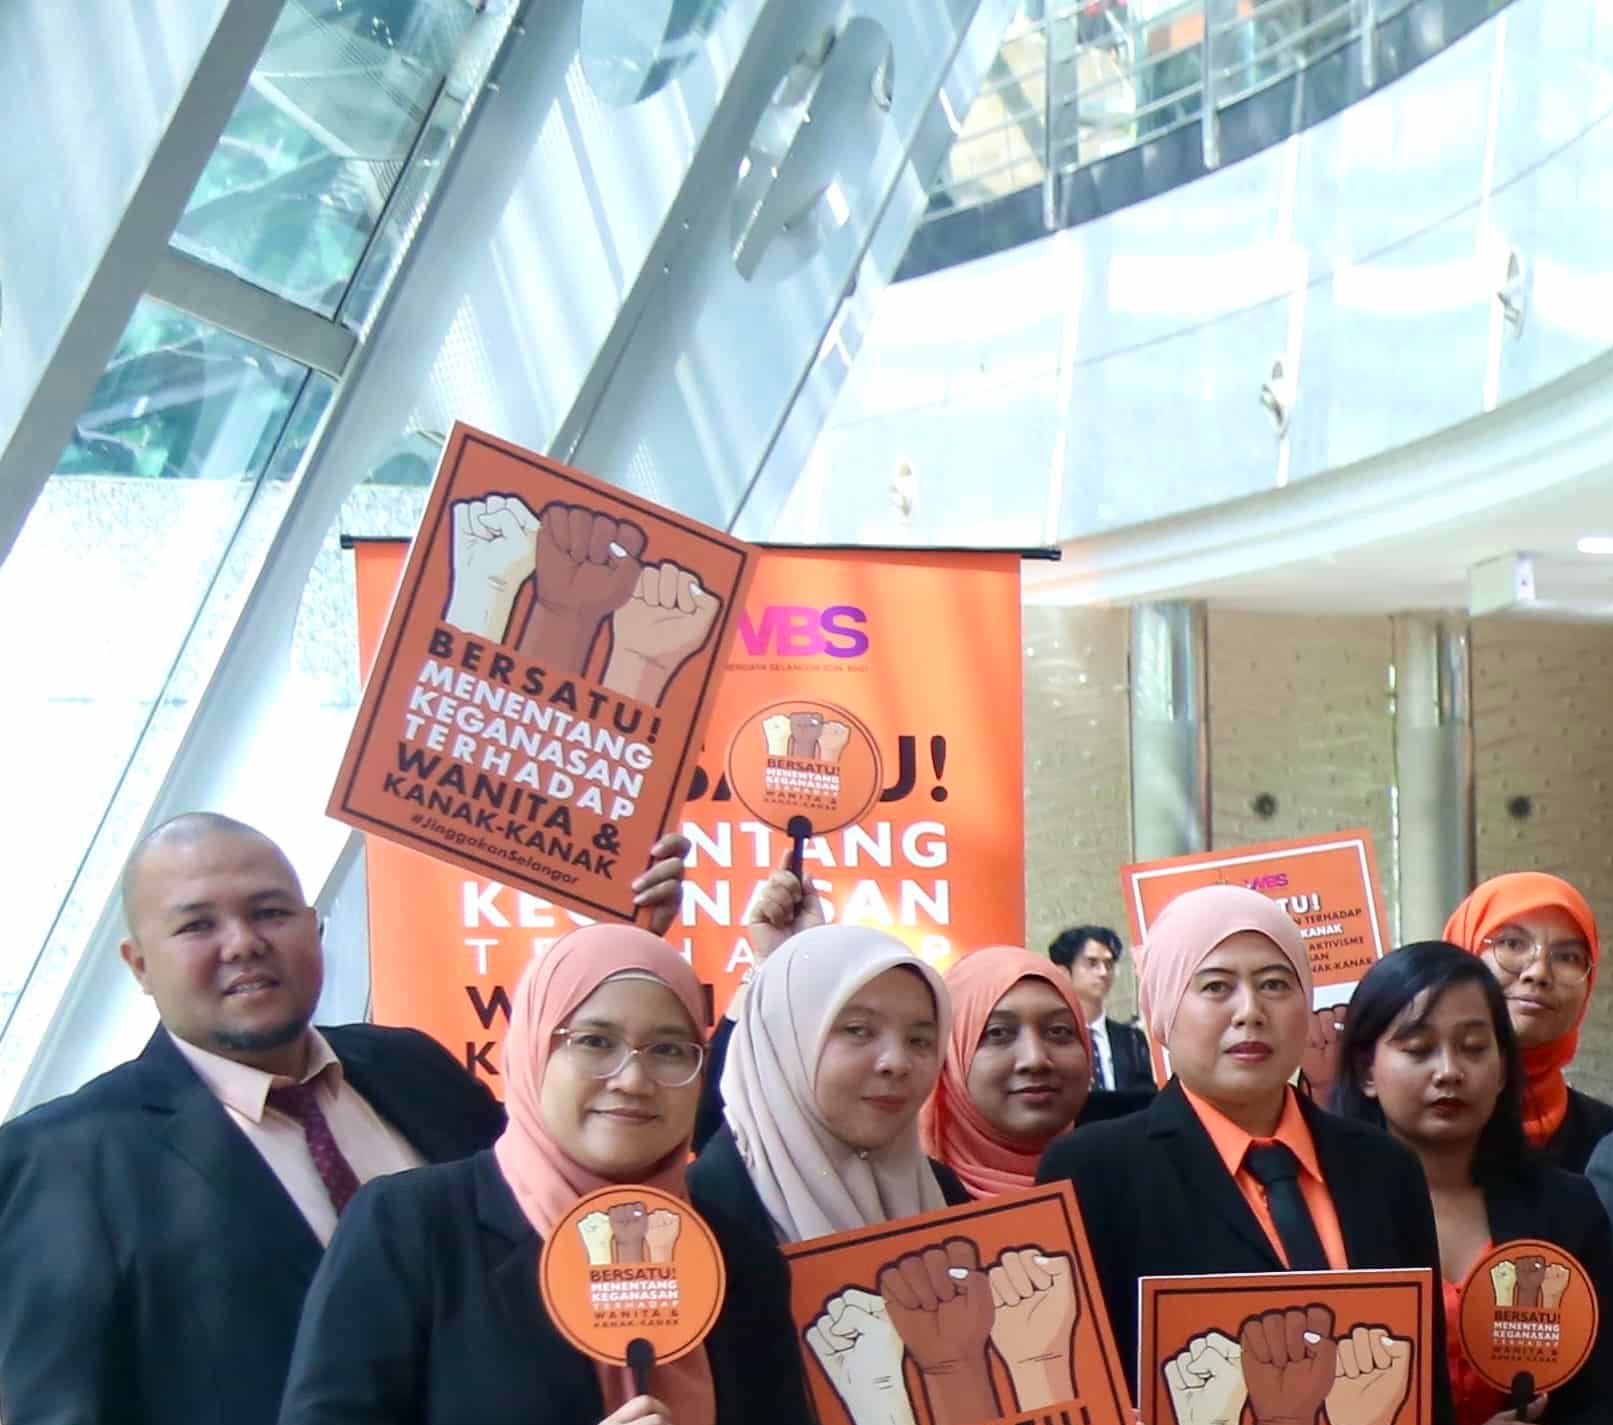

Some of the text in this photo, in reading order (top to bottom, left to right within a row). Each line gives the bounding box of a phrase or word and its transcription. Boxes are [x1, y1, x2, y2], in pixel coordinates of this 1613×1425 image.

[419, 660, 653, 770] MENENTANG
[428, 628, 661, 743] BERSATU!
[404, 713, 634, 821] TERHADAP
[409, 685, 644, 798] KEGANASAN
[383, 773, 617, 880] KANAK-KANAK
[398, 741, 620, 855] WANITA &
[410, 812, 580, 885] #JinggakanSelangor
[590, 1267, 676, 1282] BERSATU!
[1493, 1321, 1560, 1332] MENENTANG
[1494, 1311, 1561, 1324] BERSATU!
[1493, 1330, 1560, 1341] KEGANASAN
